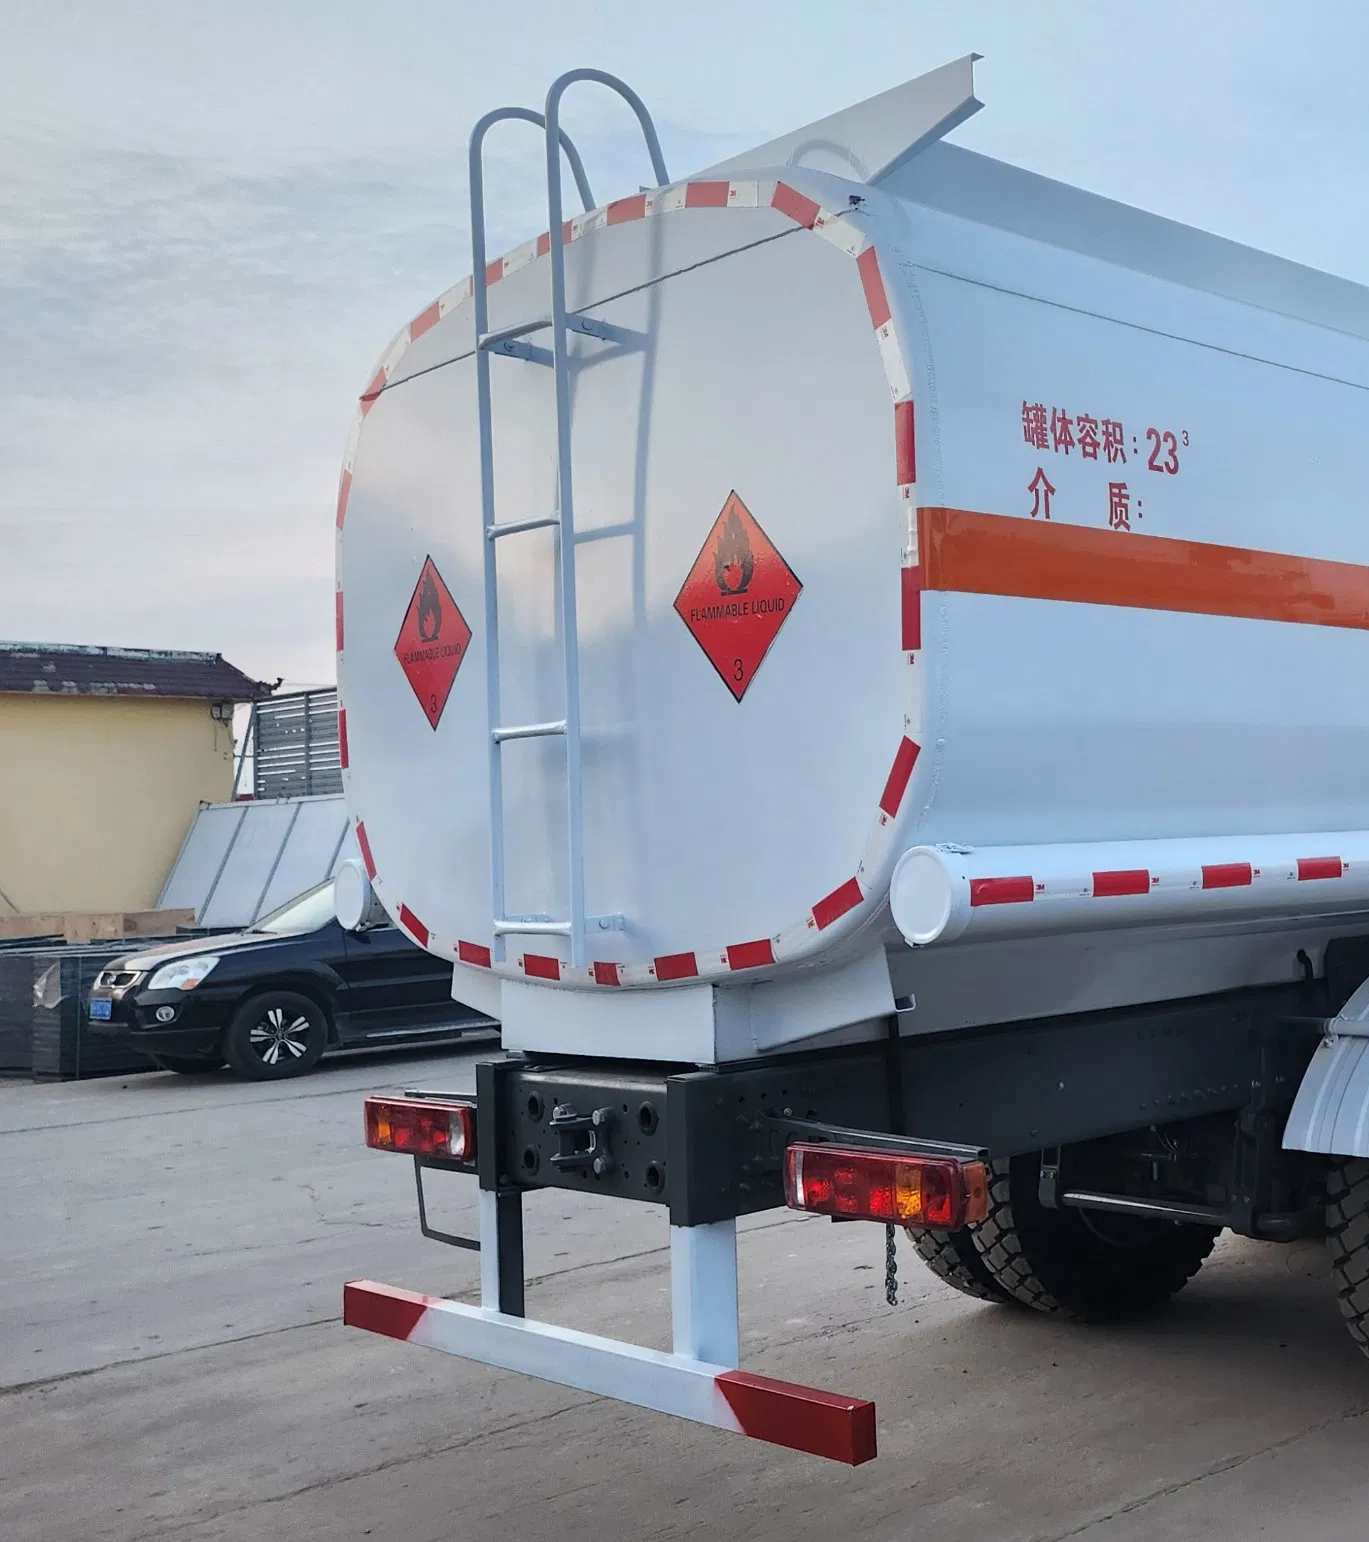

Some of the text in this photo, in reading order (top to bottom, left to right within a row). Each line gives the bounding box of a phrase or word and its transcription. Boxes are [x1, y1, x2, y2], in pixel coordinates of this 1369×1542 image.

[1027, 466, 1056, 520] 介
[690, 597, 785, 622] FLAMMABLE LIQUID
[733, 658, 743, 682] 3
[430, 693, 437, 713] 3
